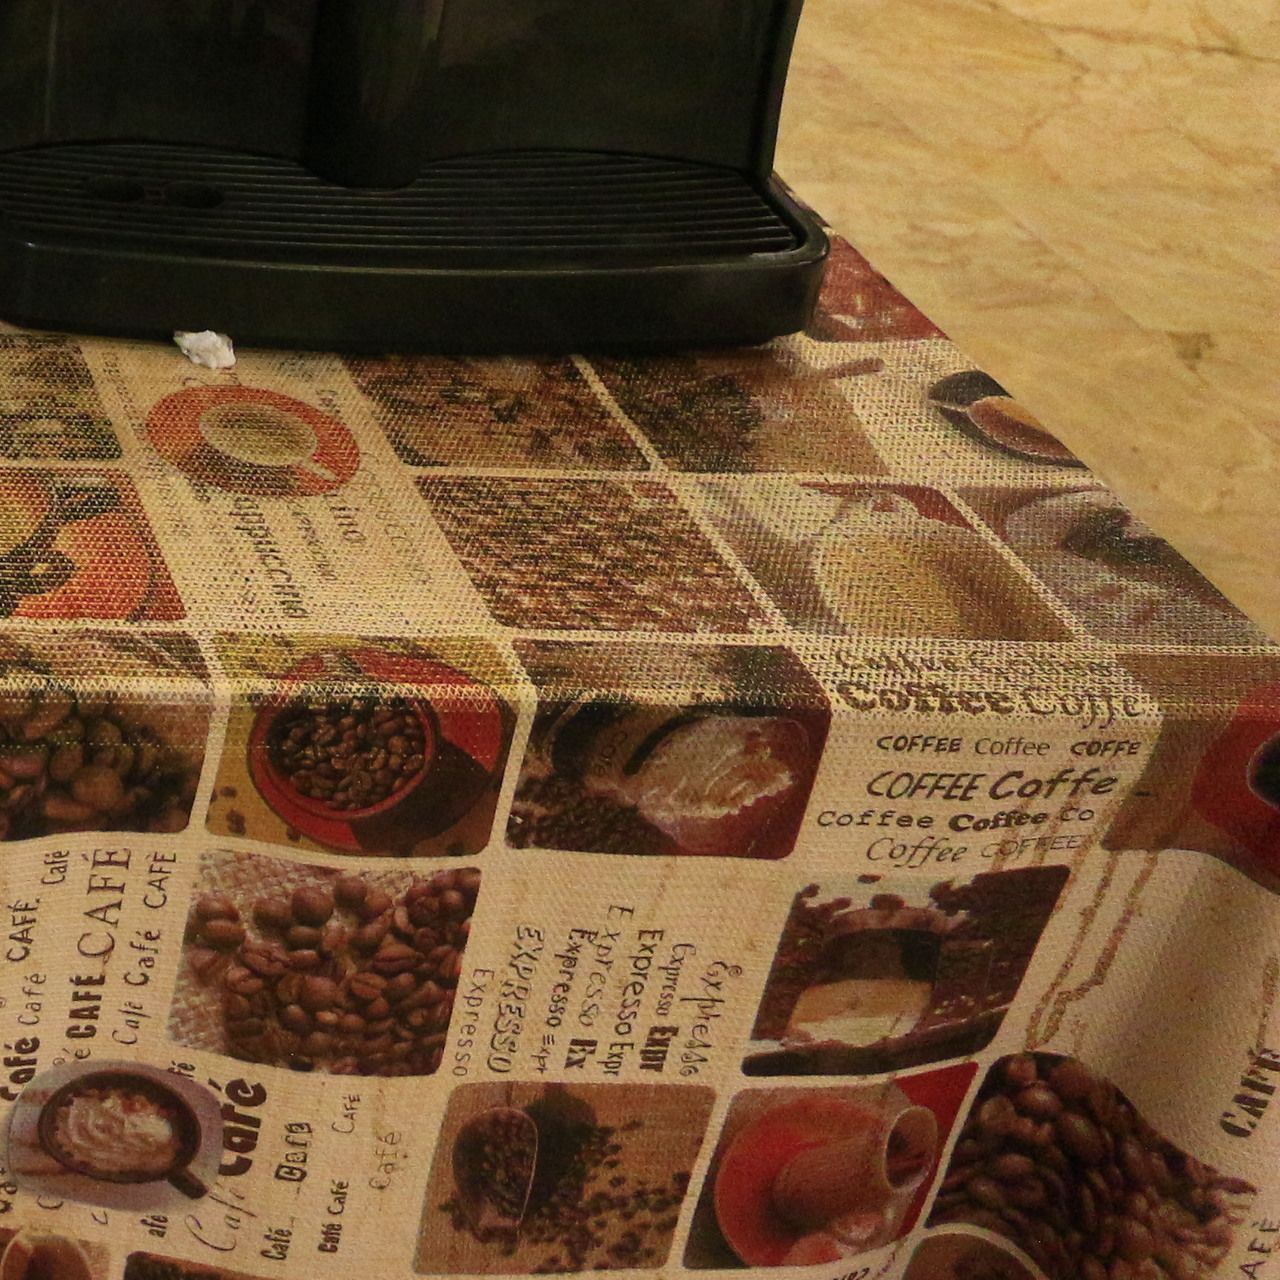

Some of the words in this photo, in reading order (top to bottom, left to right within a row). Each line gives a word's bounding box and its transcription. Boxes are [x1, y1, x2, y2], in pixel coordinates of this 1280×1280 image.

[876, 735, 962, 752] COFFEE
[975, 737, 1050, 756] Coffee
[1071, 740, 1141, 756] COFFE
[867, 771, 987, 801] COFFEE
[988, 768, 1119, 800] Coffe
[817, 810, 933, 828] Coffee
[948, 810, 1048, 832] Coffee
[1059, 808, 1094, 822] Co
[42, 850, 70, 885] Café
[866, 835, 968, 868] Coffee
[980, 835, 1083, 858] COFFEE
[77, 847, 132, 958] CAFÉ
[123, 929, 161, 986] Café
[546, 928, 592, 1028] Expresso
[614, 929, 664, 1036] Expresso
[656, 943, 696, 1016] Expresso
[18, 973, 46, 1025] Café
[65, 973, 105, 1039] CAFÉ
[452, 969, 494, 1076] Expresso
[488, 924, 544, 1074] EXPRESSO
[597, 1042, 634, 1076] Expr
[328, 1180, 349, 1215] Café
[260, 1227, 292, 1261] Café
